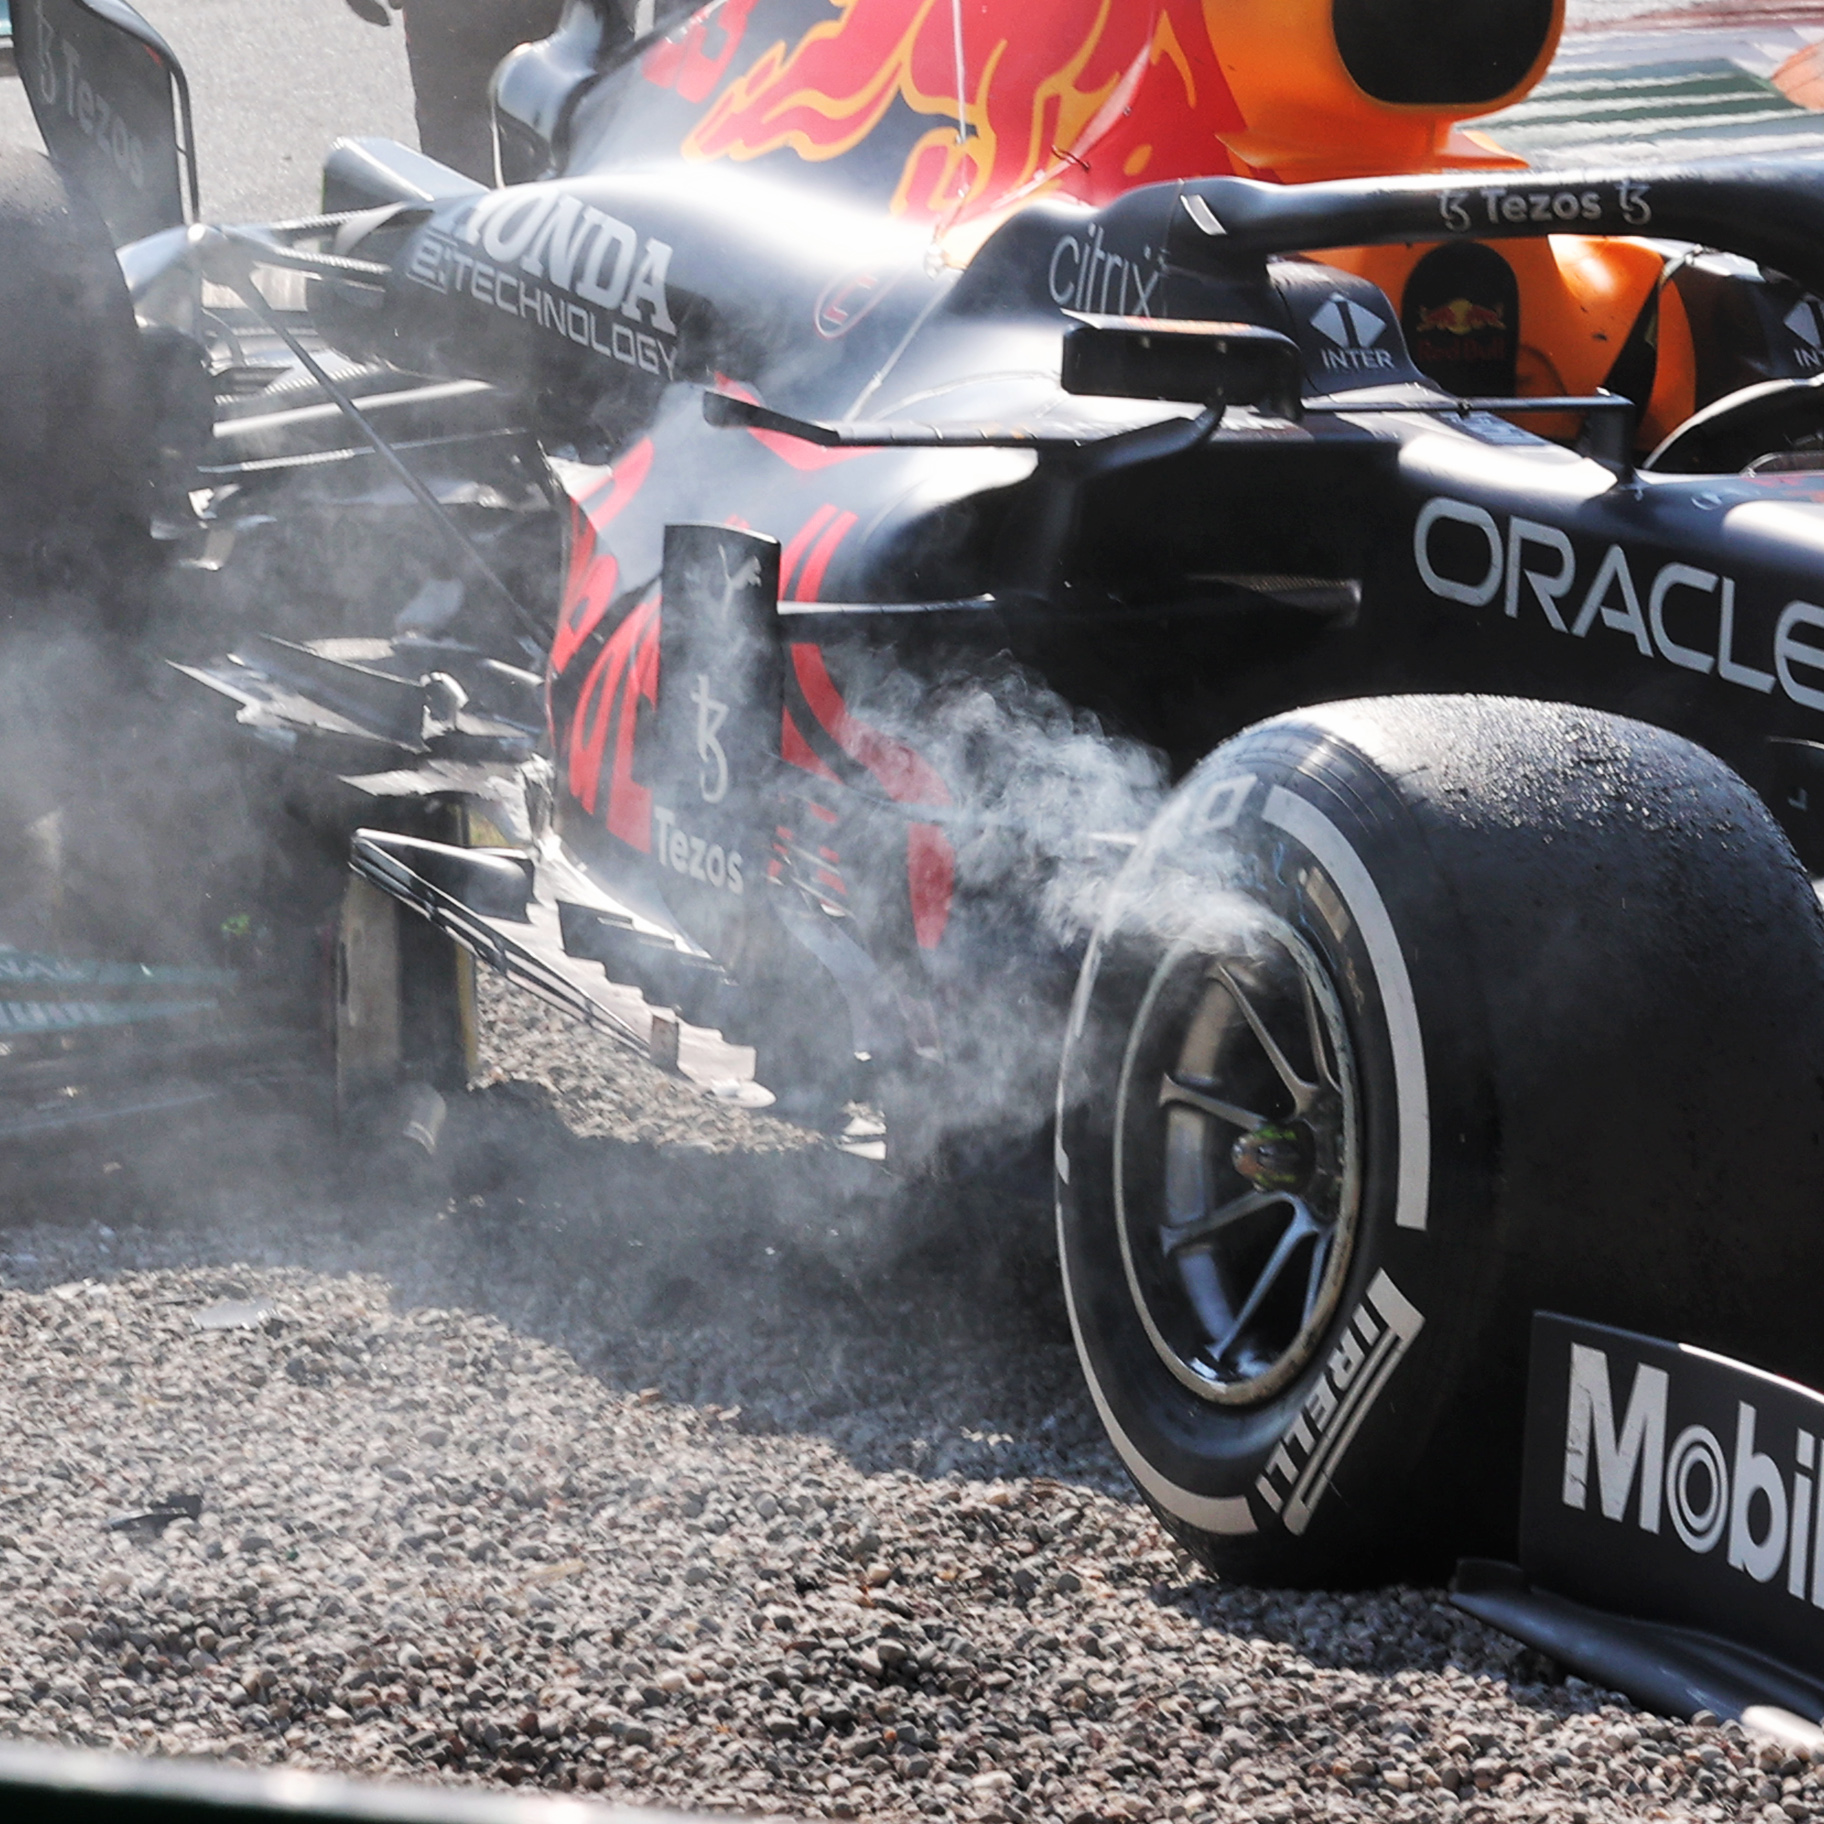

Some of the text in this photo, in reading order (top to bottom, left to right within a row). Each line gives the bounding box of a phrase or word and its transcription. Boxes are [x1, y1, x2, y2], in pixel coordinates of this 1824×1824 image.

[62, 38, 146, 189] Tezos
[1481, 188, 1602, 225] Tezos
[432, 186, 678, 336] HONDA
[1048, 223, 1159, 318] citrix
[1321, 347, 1397, 372] INTER
[653, 806, 744, 896] Tezos
[1255, 1267, 1426, 1536] PIRELLI
